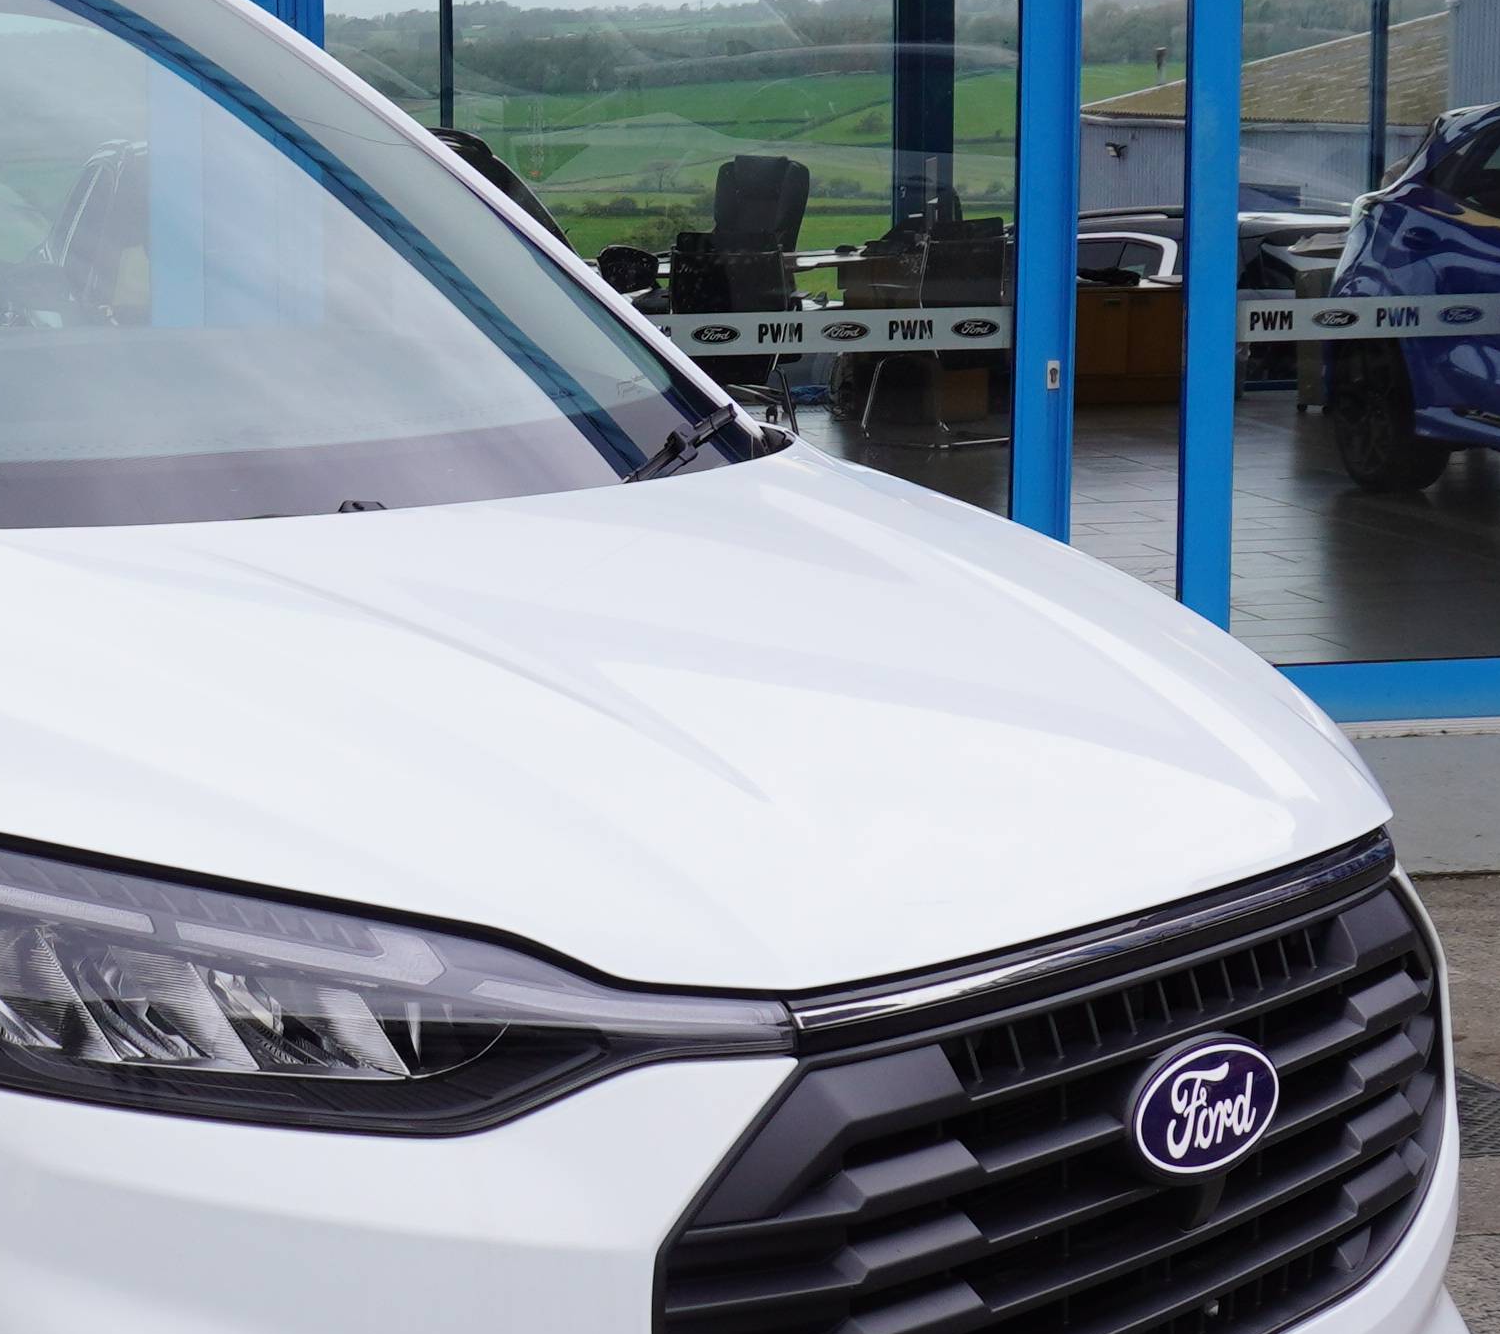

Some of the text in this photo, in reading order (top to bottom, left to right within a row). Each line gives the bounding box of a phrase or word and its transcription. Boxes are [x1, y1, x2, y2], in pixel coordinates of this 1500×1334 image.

[699, 319, 992, 344] Ford PWM Ford PWM Ford
[1250, 310, 1294, 331] PWM
[1321, 312, 1352, 327] Ford
[1375, 307, 1420, 328] PWM
[1166, 1060, 1257, 1161] Ford
